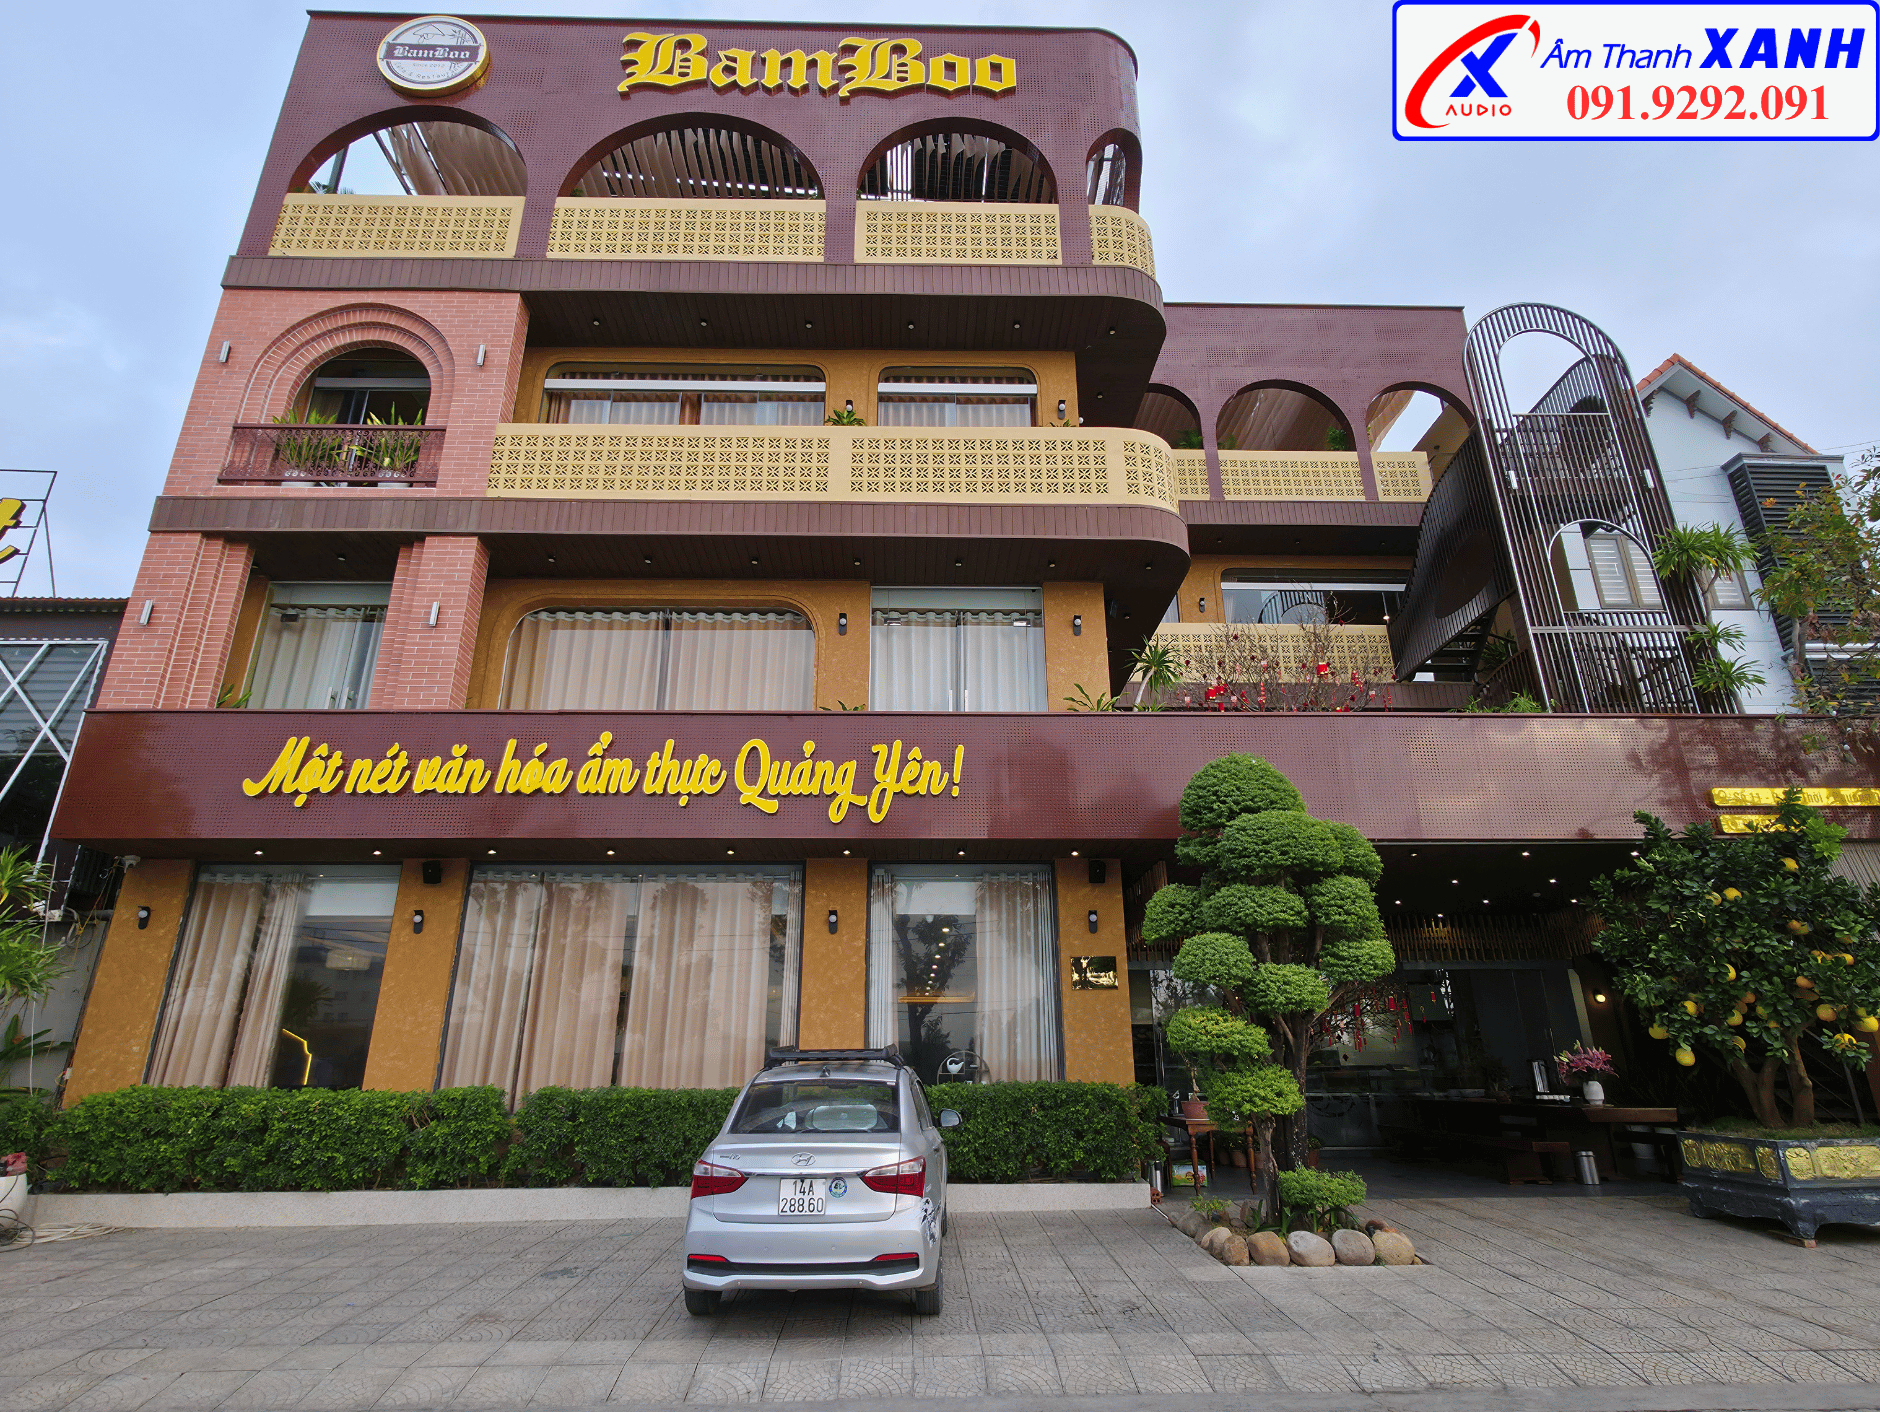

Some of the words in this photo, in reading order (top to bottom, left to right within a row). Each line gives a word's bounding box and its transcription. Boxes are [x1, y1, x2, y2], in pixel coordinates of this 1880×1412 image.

[617, 31, 1017, 97] BamBoo
[243, 736, 344, 807] Một
[345, 742, 411, 794] nét
[412, 744, 492, 794] văn
[494, 738, 574, 795] hóa
[577, 731, 641, 794] ẩm
[643, 739, 727, 807] thực
[734, 738, 868, 823] Quảng
[780, 1197, 824, 1214] 288.60
[792, 1180, 815, 1197] 14A
